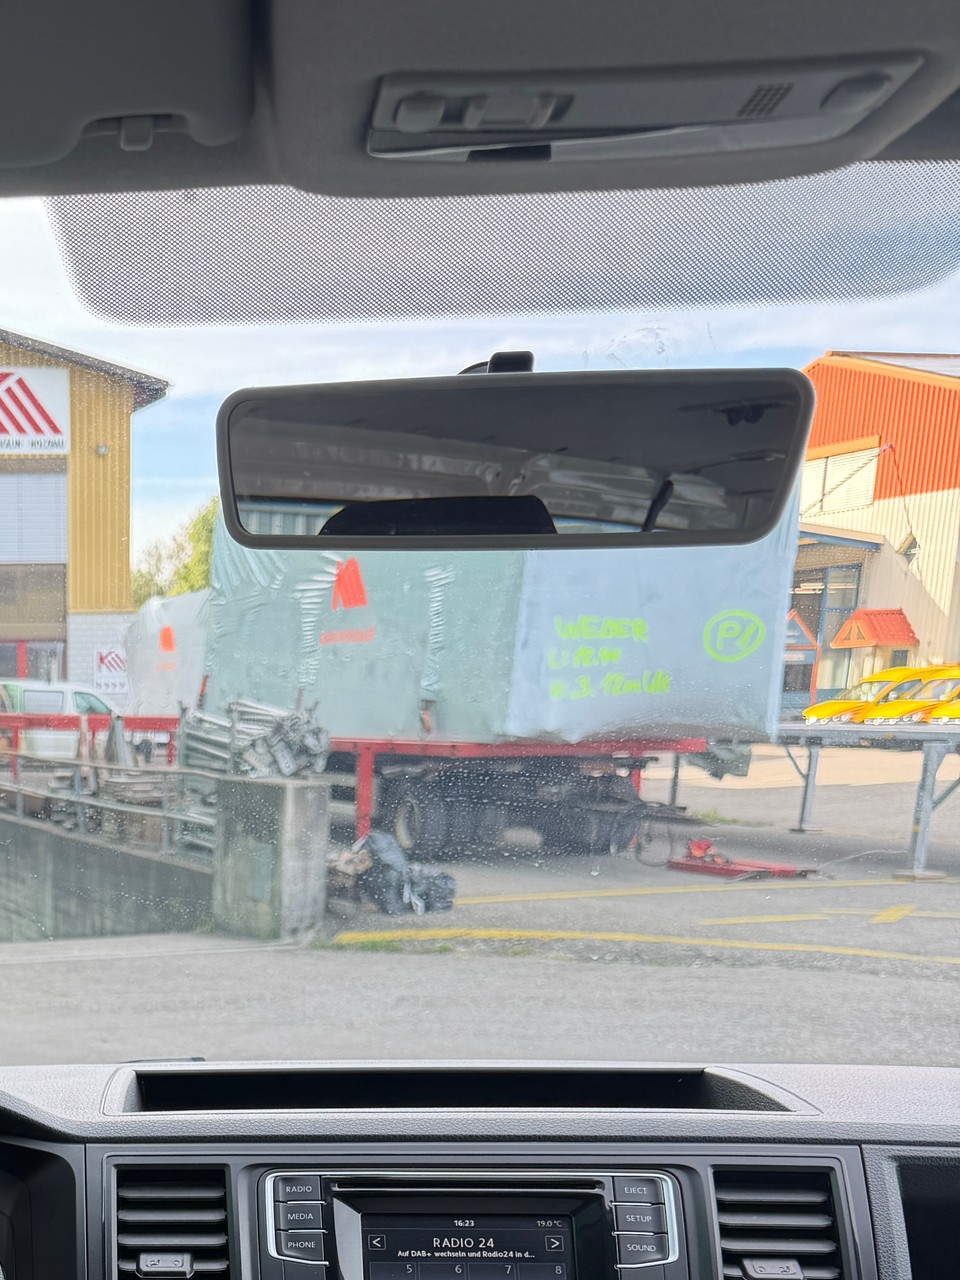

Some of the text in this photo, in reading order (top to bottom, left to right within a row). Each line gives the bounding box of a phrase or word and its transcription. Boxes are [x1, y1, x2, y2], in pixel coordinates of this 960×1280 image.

[285, 1185, 313, 1193] RADIO
[624, 1186, 648, 1195] EJECT
[453, 1219, 475, 1227] 16:23
[625, 1214, 652, 1223] SETUP
[536, 1220, 552, 1228] 19.0
[433, 1237, 494, 1248] RADIO 24
[626, 1243, 657, 1252] SOUND
[397, 1250, 409, 1258] Auf
[411, 1250, 432, 1258] DAB+
[434, 1250, 467, 1258] wechseln
[468, 1250, 481, 1258] und
[482, 1250, 514, 1259] Radio24
[515, 1251, 522, 1259] in
[406, 1264, 413, 1273] 5
[455, 1264, 462, 1274] 6
[505, 1264, 512, 1274] 7
[555, 1265, 562, 1275] 8
